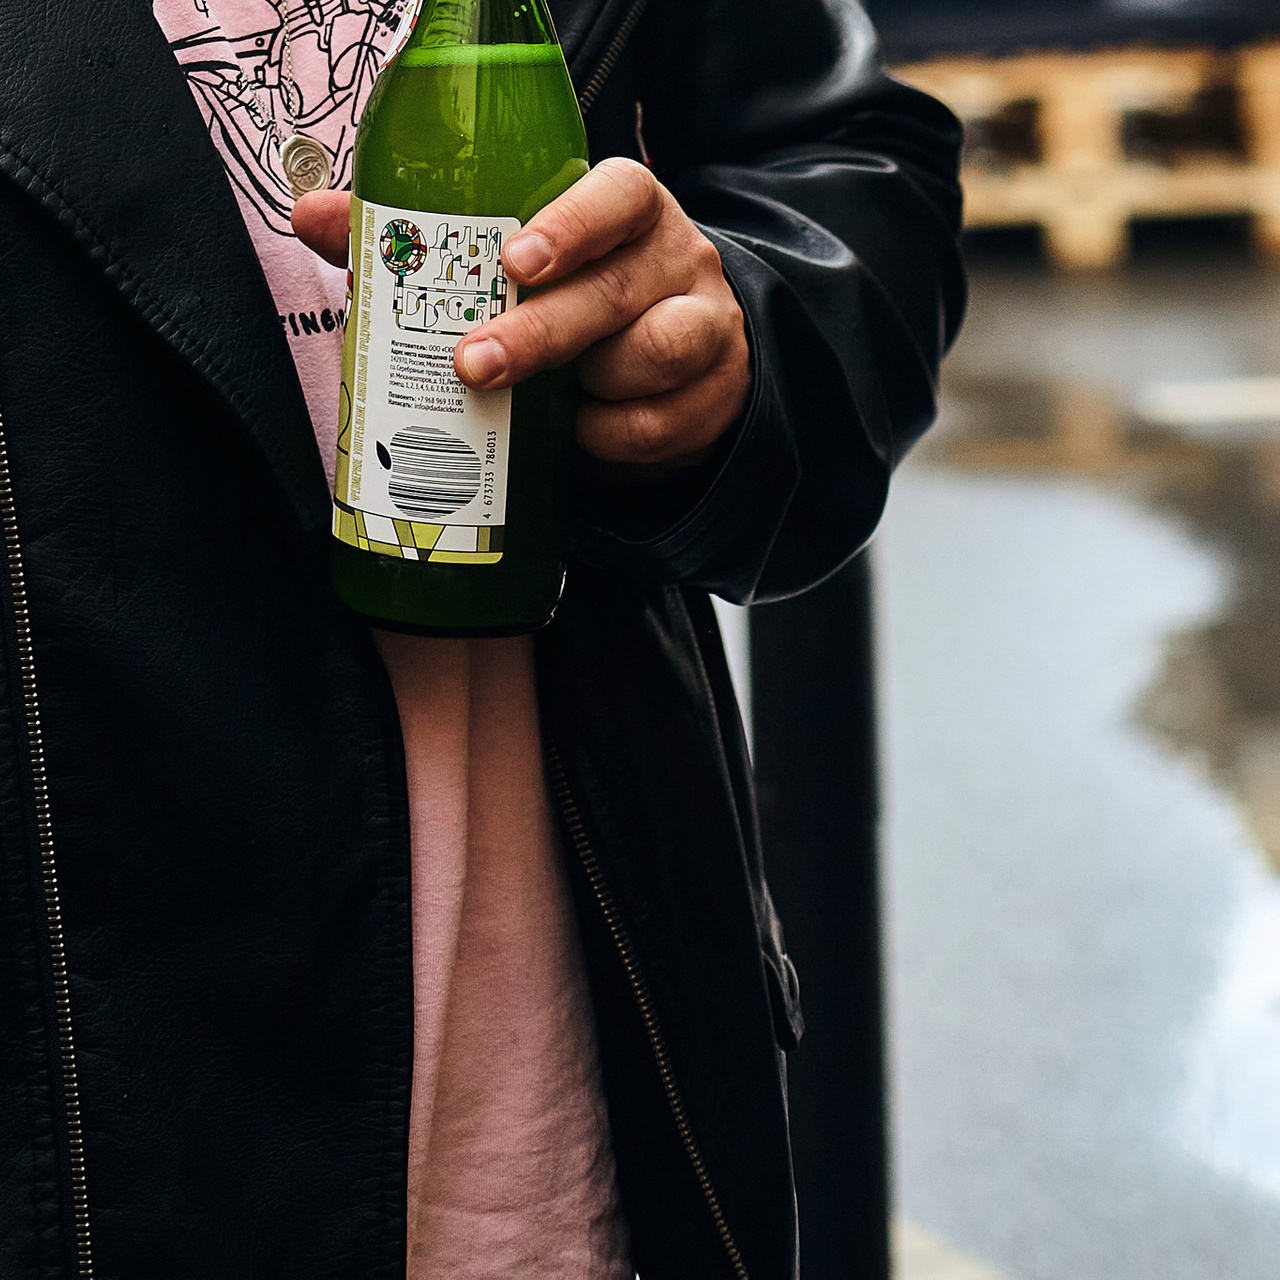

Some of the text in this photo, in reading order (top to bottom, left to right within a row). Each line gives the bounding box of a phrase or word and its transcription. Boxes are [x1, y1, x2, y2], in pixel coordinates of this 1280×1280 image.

[350, 207, 375, 501] ЧРЕЗМЕРНОЕ УПОТРЕБЛЕНИЕ АЛКОГОЛЬНОЙ ПРОДУКЦИИ ВРЕДИТ ВАШЕМУ ЗДОРОВЬЮ
[426, 361, 454, 369] Московска
[485, 430, 497, 465] 786013
[483, 471, 494, 506] 673733
